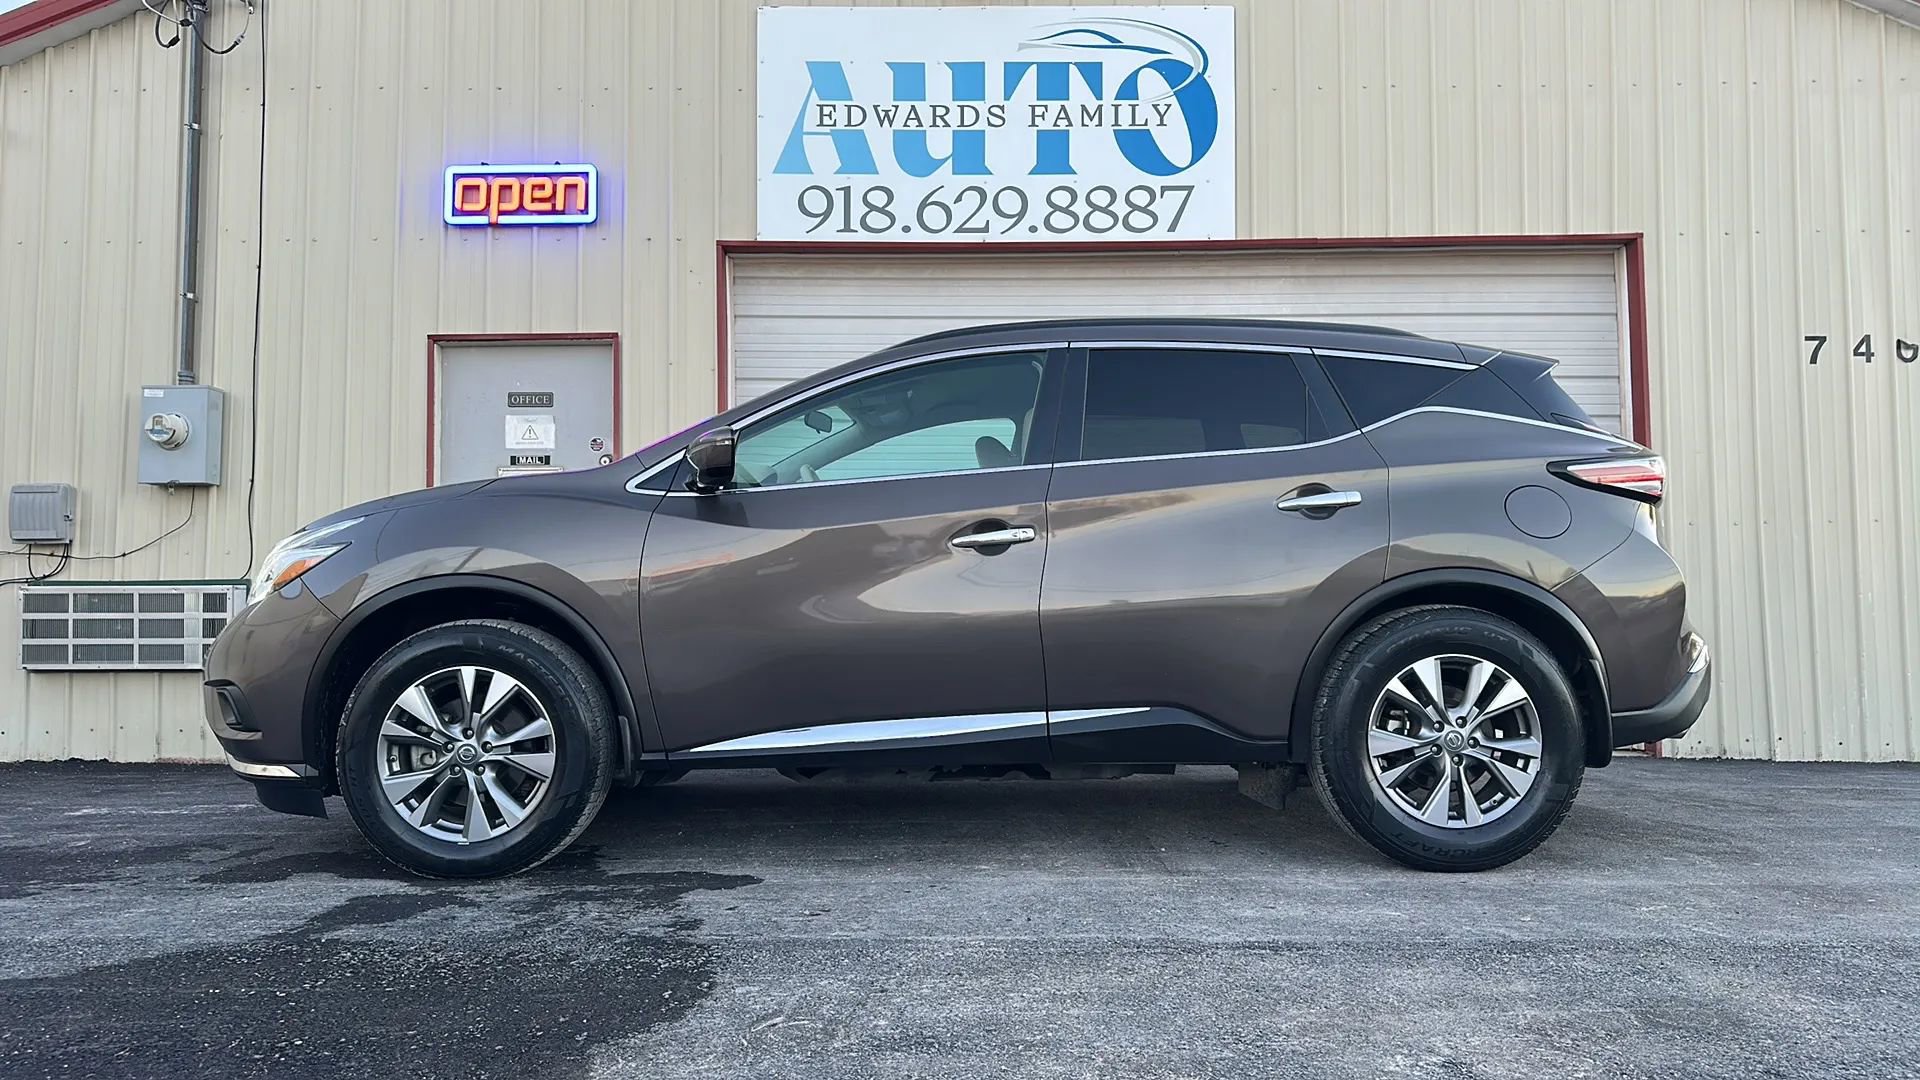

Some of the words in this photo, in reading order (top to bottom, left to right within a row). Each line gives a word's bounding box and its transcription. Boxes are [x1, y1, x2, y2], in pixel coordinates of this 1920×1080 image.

[772, 58, 1218, 177] AUTO
[816, 103, 1007, 129] EDWARDS
[1028, 102, 1173, 128] FAMILY
[454, 176, 586, 224] open
[798, 184, 1195, 235] 918.629.8887
[511, 395, 550, 404] OFFICE
[519, 456, 542, 464] MAIL
